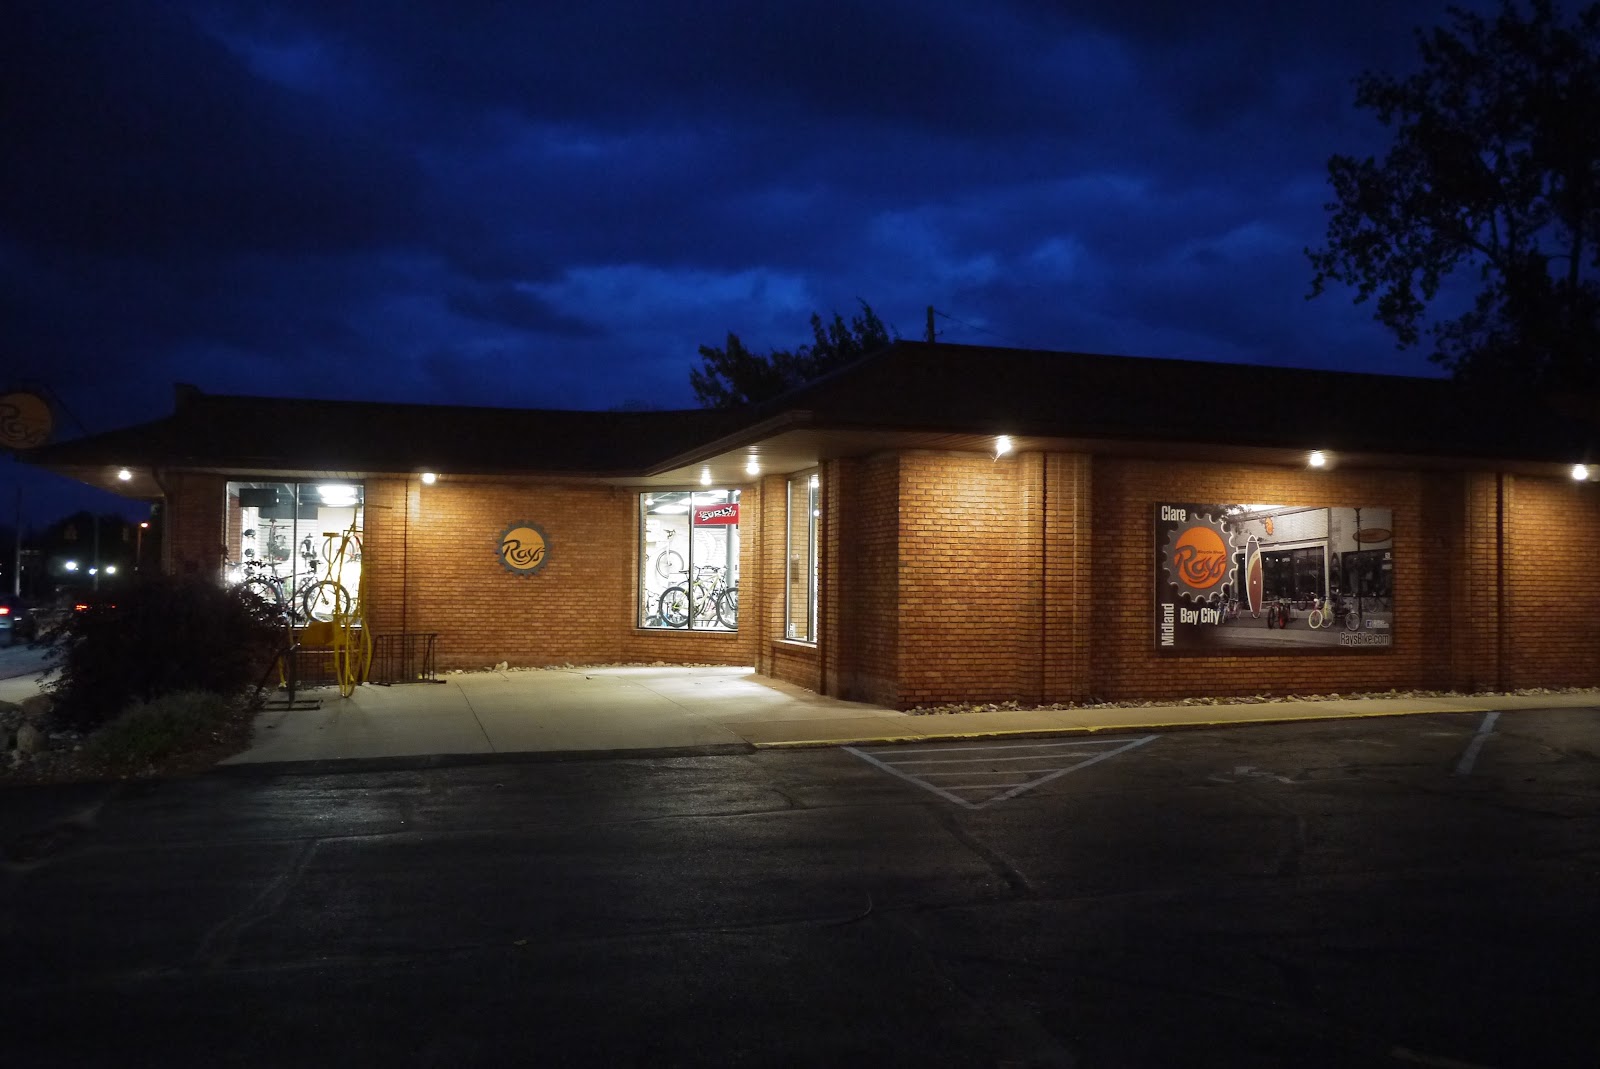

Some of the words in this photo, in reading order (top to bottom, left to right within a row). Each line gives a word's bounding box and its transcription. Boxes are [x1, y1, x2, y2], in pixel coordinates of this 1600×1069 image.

[702, 505, 733, 521] SURLY
[1161, 505, 1186, 521] Clare
[502, 539, 545, 566] Rays
[1161, 603, 1175, 646] Midland
[1180, 607, 1199, 625] Bay
[1200, 607, 1220, 625] City
[1340, 632, 1390, 647] RaysBike.com
